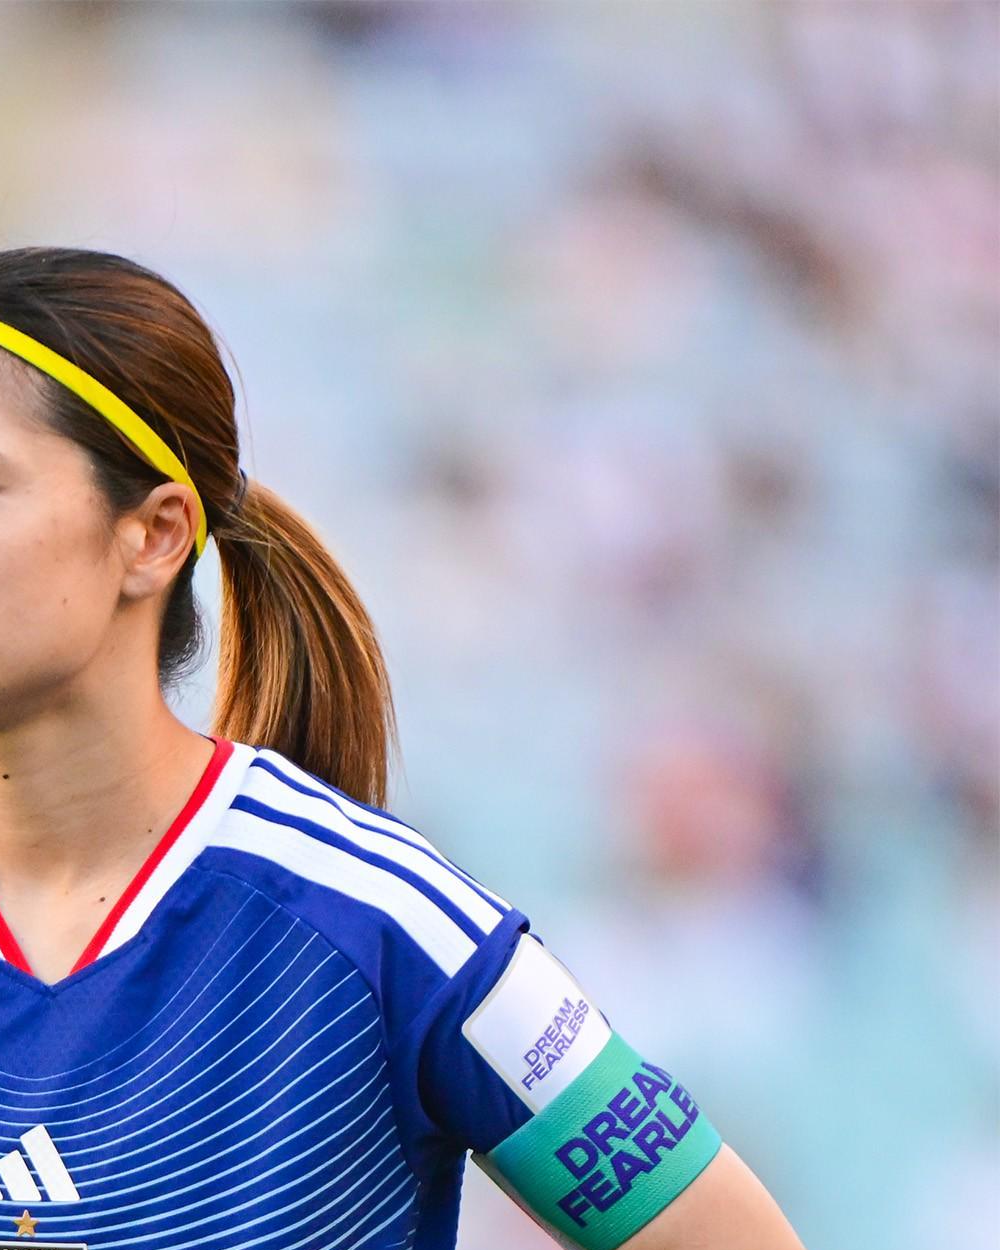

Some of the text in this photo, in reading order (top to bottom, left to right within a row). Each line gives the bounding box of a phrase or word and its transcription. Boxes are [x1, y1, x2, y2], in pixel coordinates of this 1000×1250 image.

[521, 1000, 589, 1091] FEARLESS
[524, 997, 575, 1067] DREAM
[554, 1062, 673, 1181] DREA
[556, 1083, 700, 1229] FEARLE
